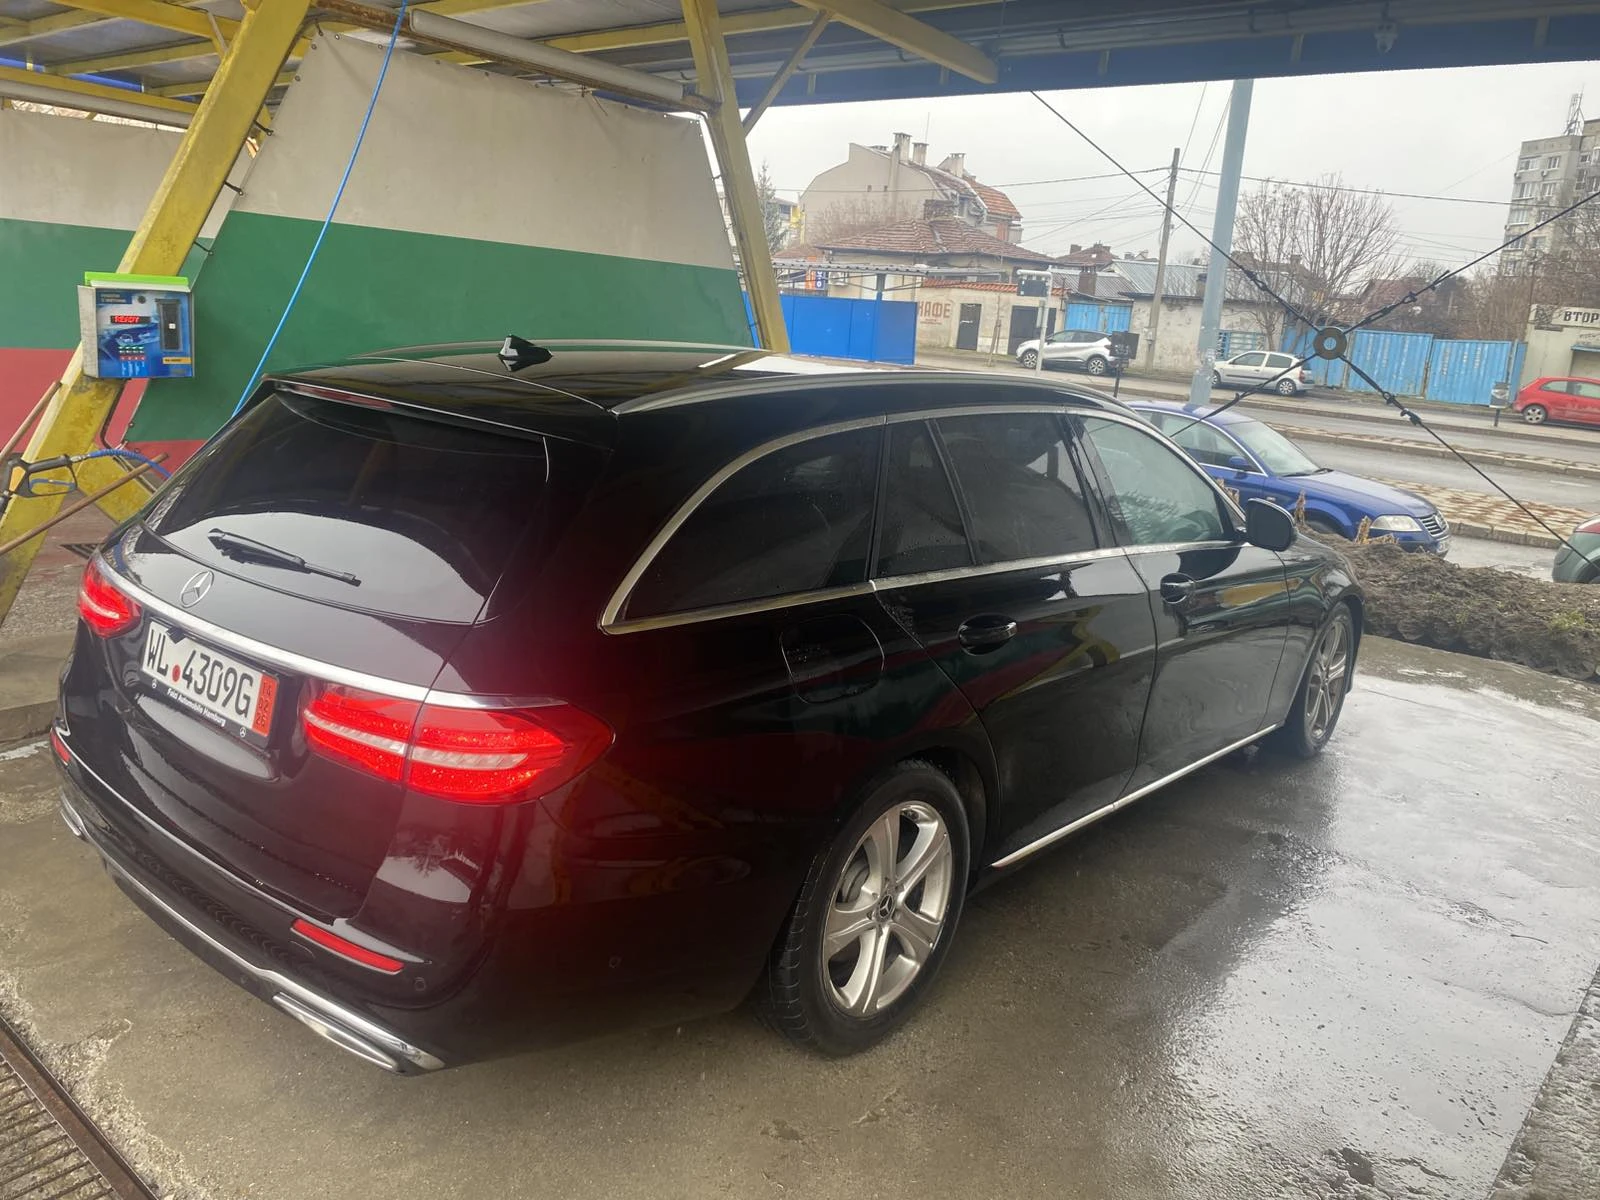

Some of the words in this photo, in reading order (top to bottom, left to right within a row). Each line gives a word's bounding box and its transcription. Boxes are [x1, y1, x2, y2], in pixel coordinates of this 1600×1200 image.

[115, 315, 139, 324] READY
[147, 628, 168, 677] WL
[182, 650, 254, 718] 4309G
[203, 708, 226, 728] Hamburg
